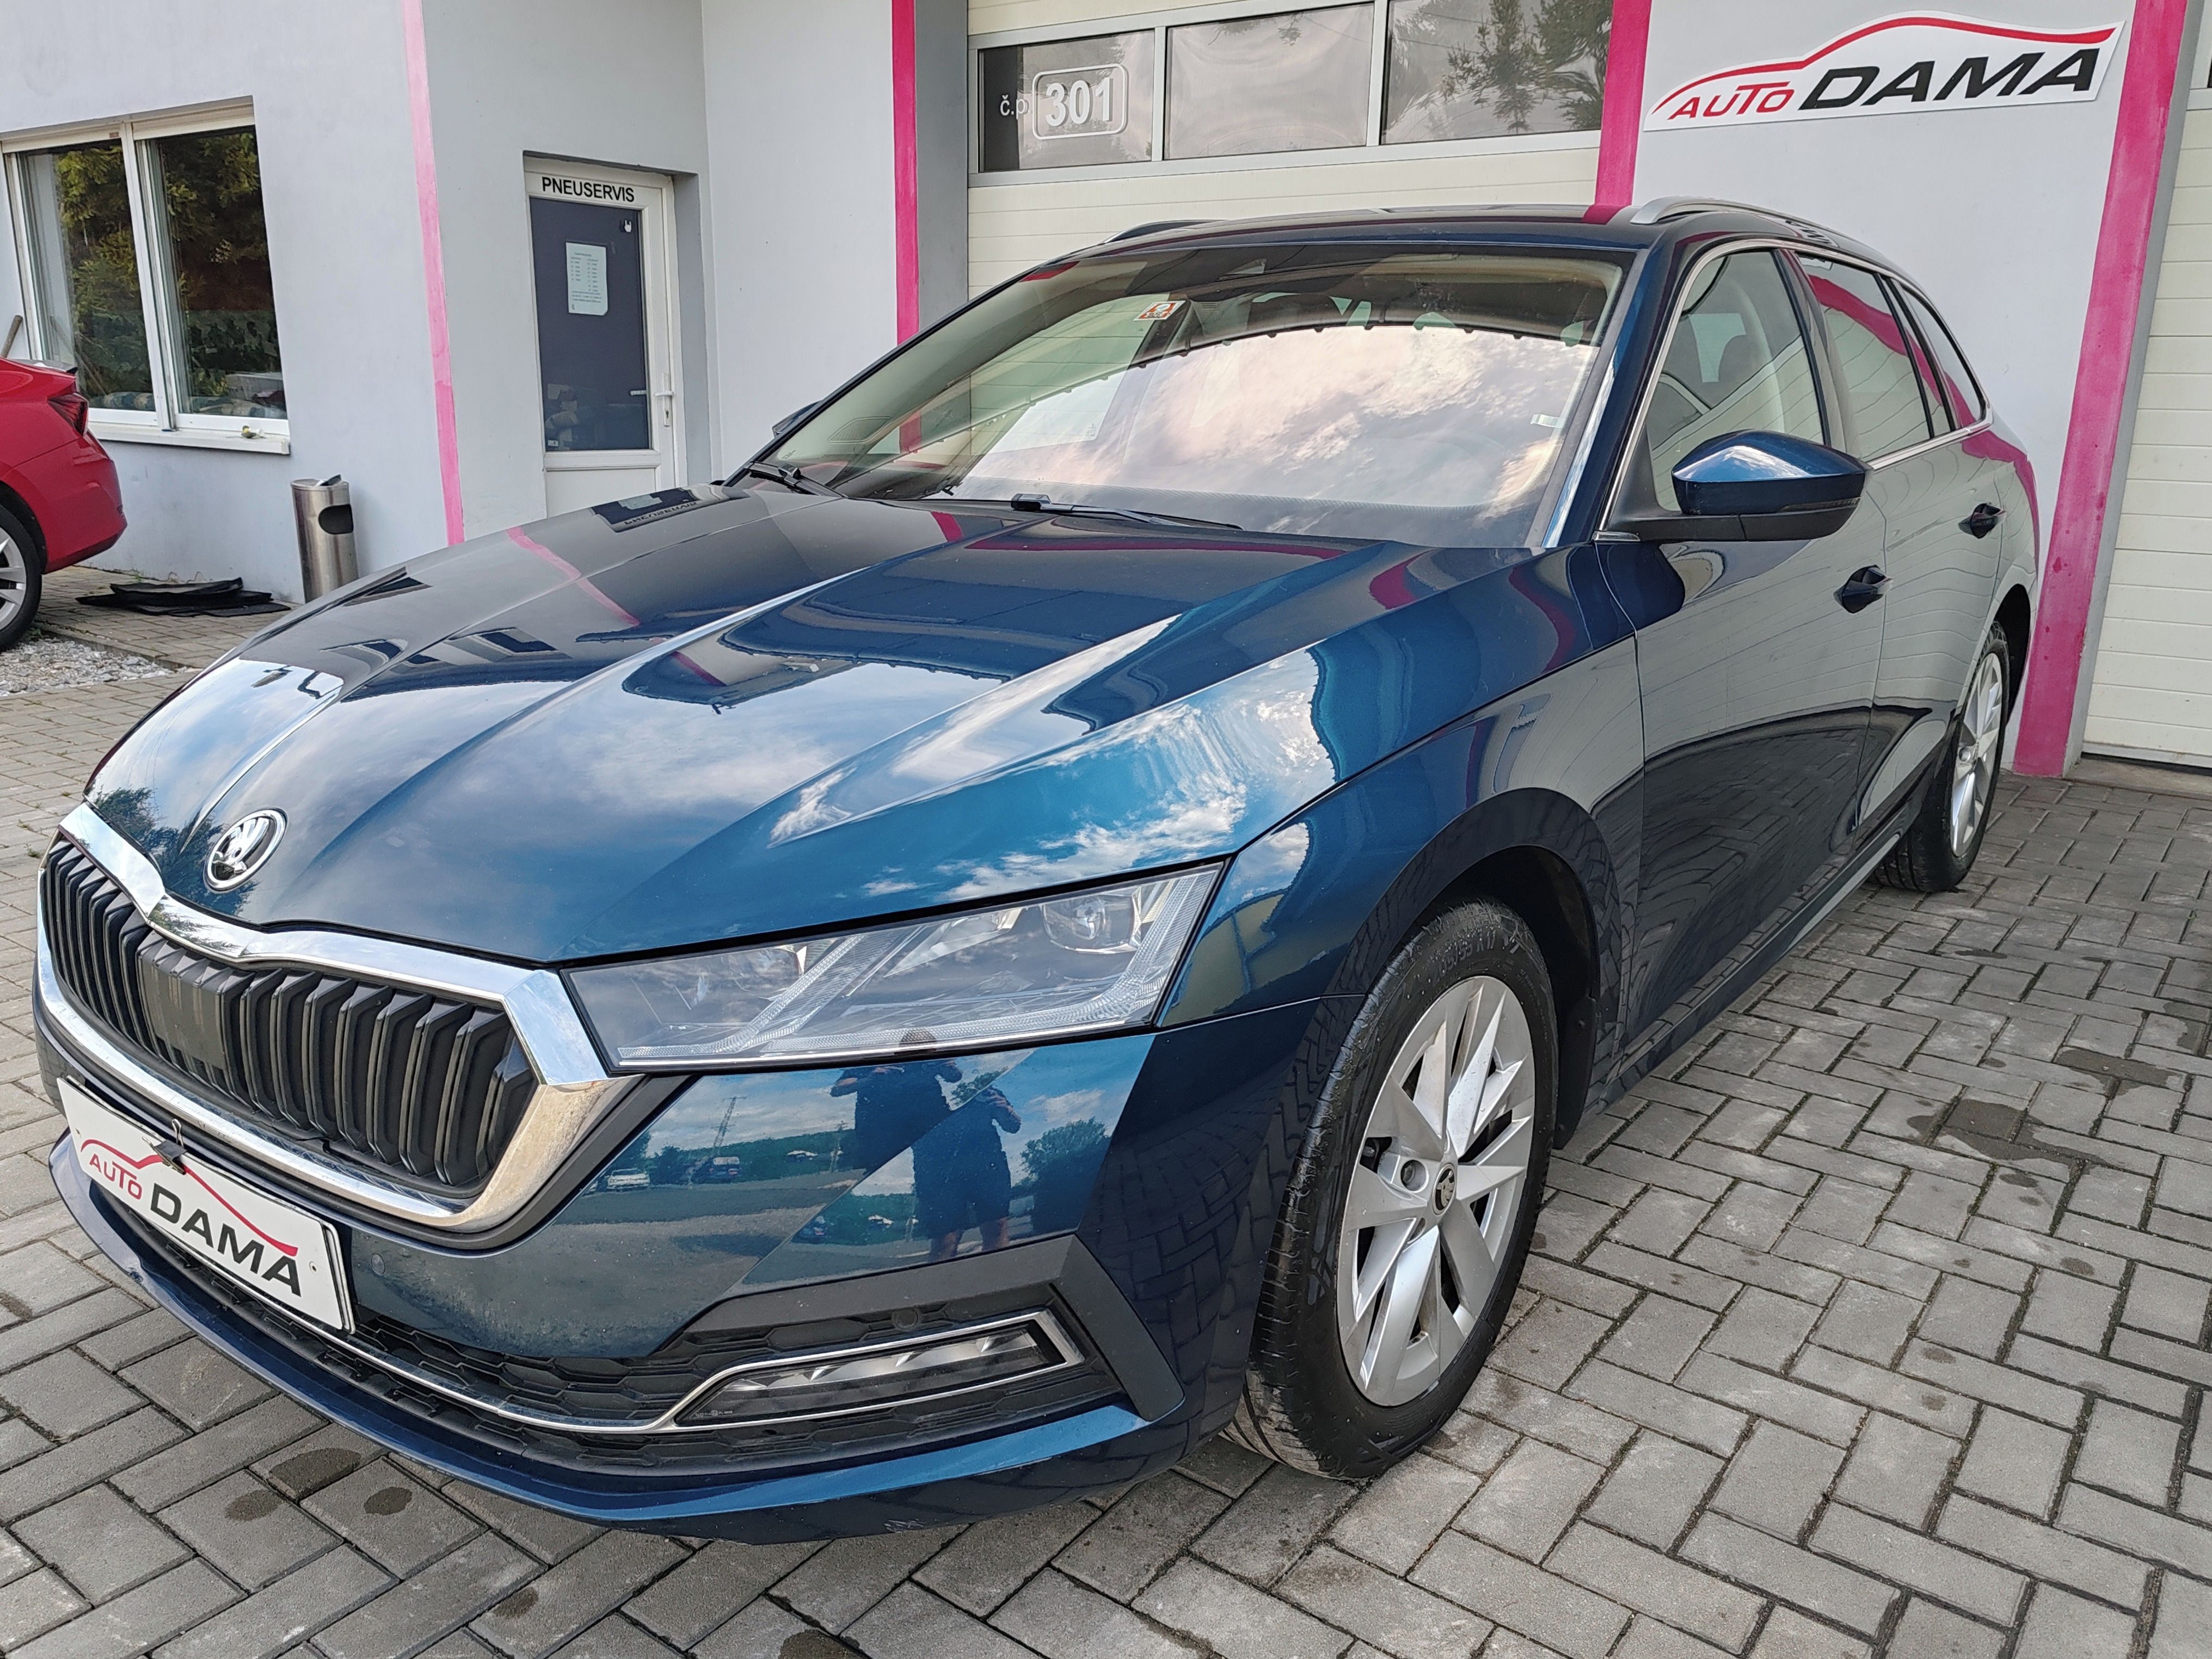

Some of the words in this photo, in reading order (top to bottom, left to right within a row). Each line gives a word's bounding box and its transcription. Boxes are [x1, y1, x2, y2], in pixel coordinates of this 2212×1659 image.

[1045, 77, 1112, 127] 301
[1667, 81, 1795, 120] AUTO
[1798, 48, 2100, 110] DAMA
[542, 176, 635, 202] PNEUSERVIS
[88, 1153, 143, 1200] AUTO
[149, 1183, 302, 1298] DAMA
